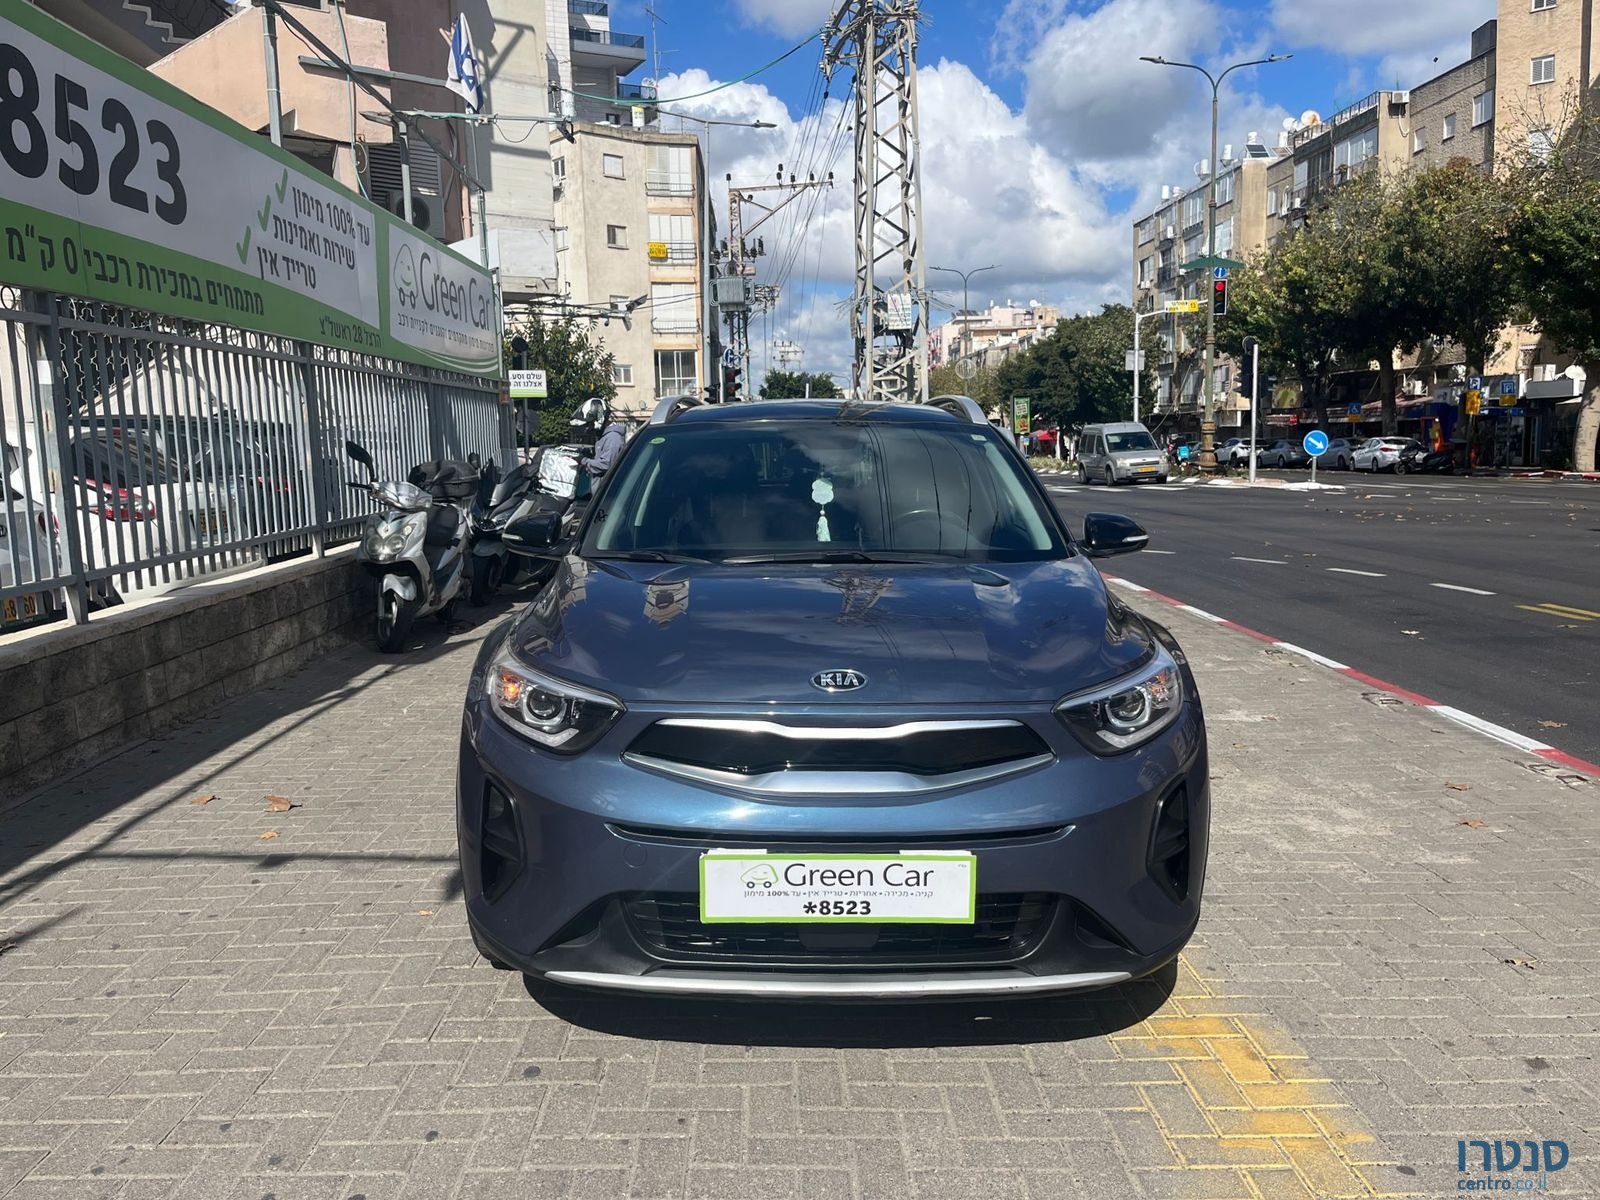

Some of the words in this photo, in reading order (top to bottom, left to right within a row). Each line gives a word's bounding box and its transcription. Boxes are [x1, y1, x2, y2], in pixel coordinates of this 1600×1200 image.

[0, 43, 187, 226] 8523
[292, 186, 325, 223] מימון
[326, 202, 356, 239] 100%
[5, 223, 55, 271] ק"מ
[272, 214, 321, 257] ואמינות
[356, 221, 370, 246] עד
[62, 237, 78, 275] 0
[83, 248, 133, 287] רכבי
[256, 246, 280, 280] אין
[323, 237, 356, 270] שירות
[136, 261, 203, 302] במכירת
[282, 255, 317, 289] טרייד
[206, 279, 265, 316] מתמחים
[420, 252, 468, 324] Green
[469, 278, 490, 332] Car
[352, 324, 363, 344] 28
[363, 327, 382, 348] הרצל
[526, 372, 542, 380] שלם
[820, 672, 859, 686] KIA
[784, 863, 874, 888] Green
[883, 863, 935, 888] Car
[744, 890, 765, 898] מימון
[808, 890, 820, 898] אין
[915, 890, 934, 899] קניה
